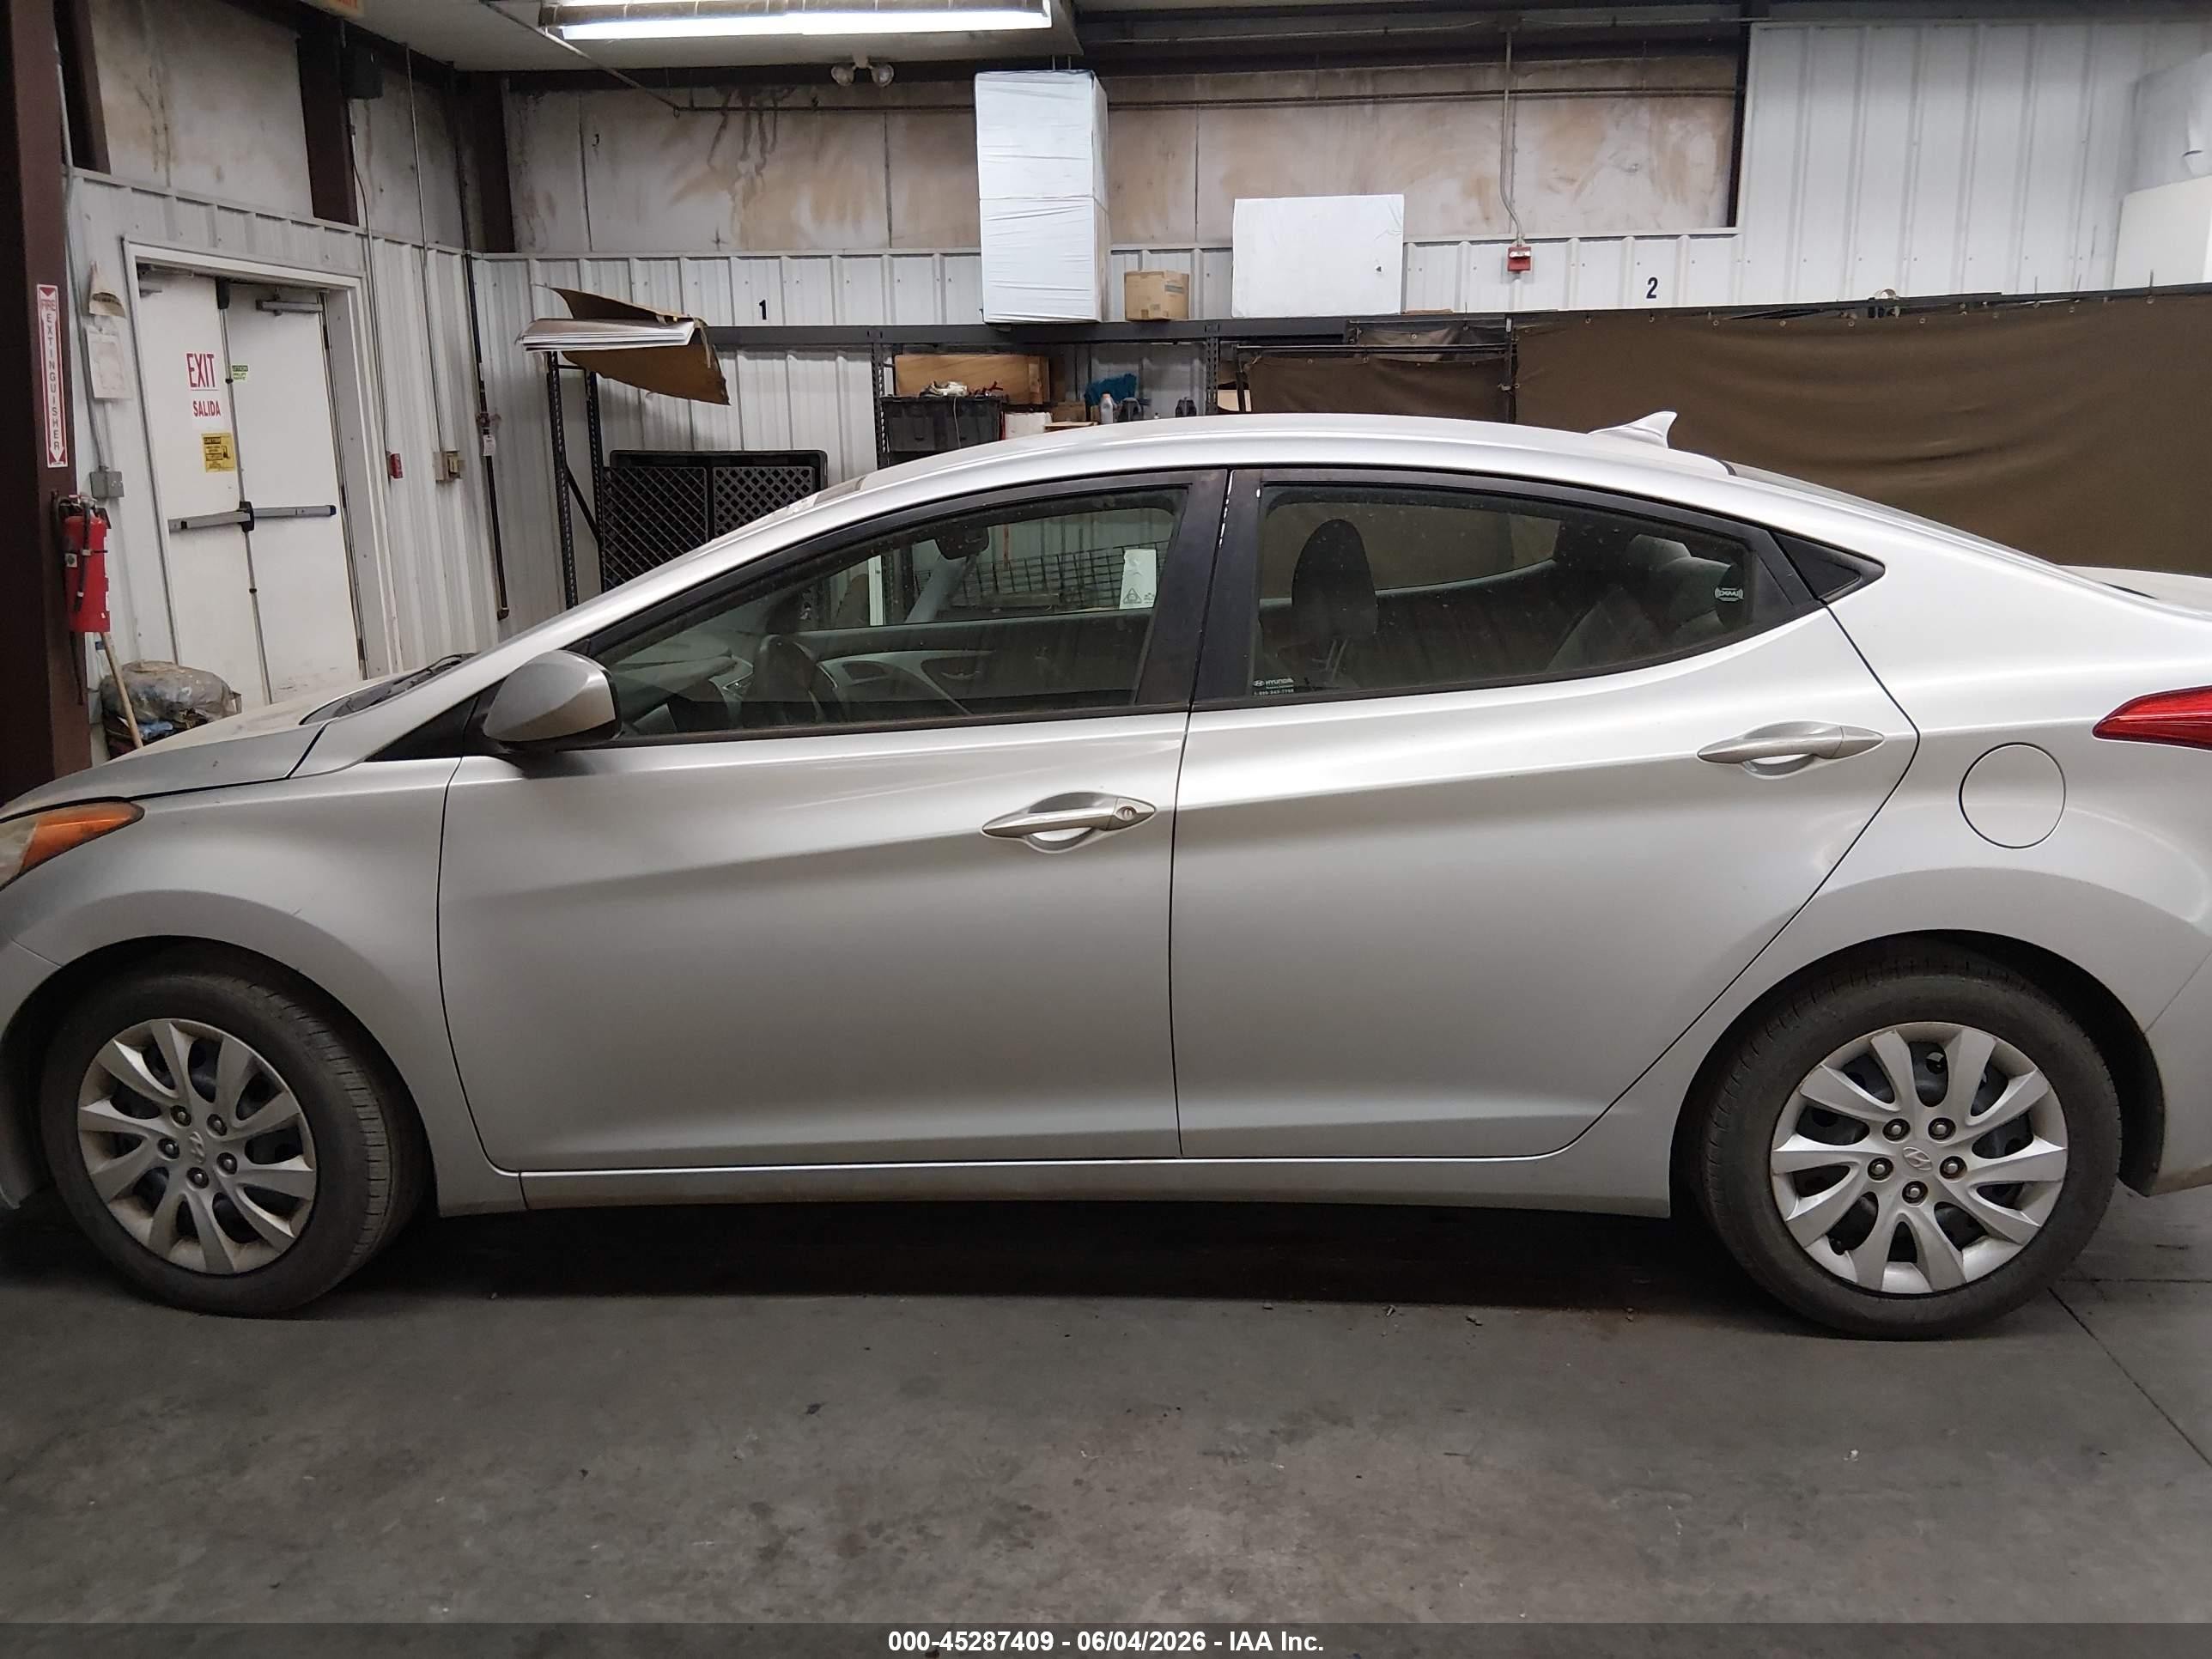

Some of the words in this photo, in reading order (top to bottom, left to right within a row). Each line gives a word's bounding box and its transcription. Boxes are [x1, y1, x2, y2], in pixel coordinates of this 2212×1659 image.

[1646, 276, 1658, 299] 2
[758, 299, 767, 320] 1
[186, 353, 216, 387] EXIT
[46, 313, 60, 451] EXTINGUISHER
[192, 400, 222, 417] SALIDA
